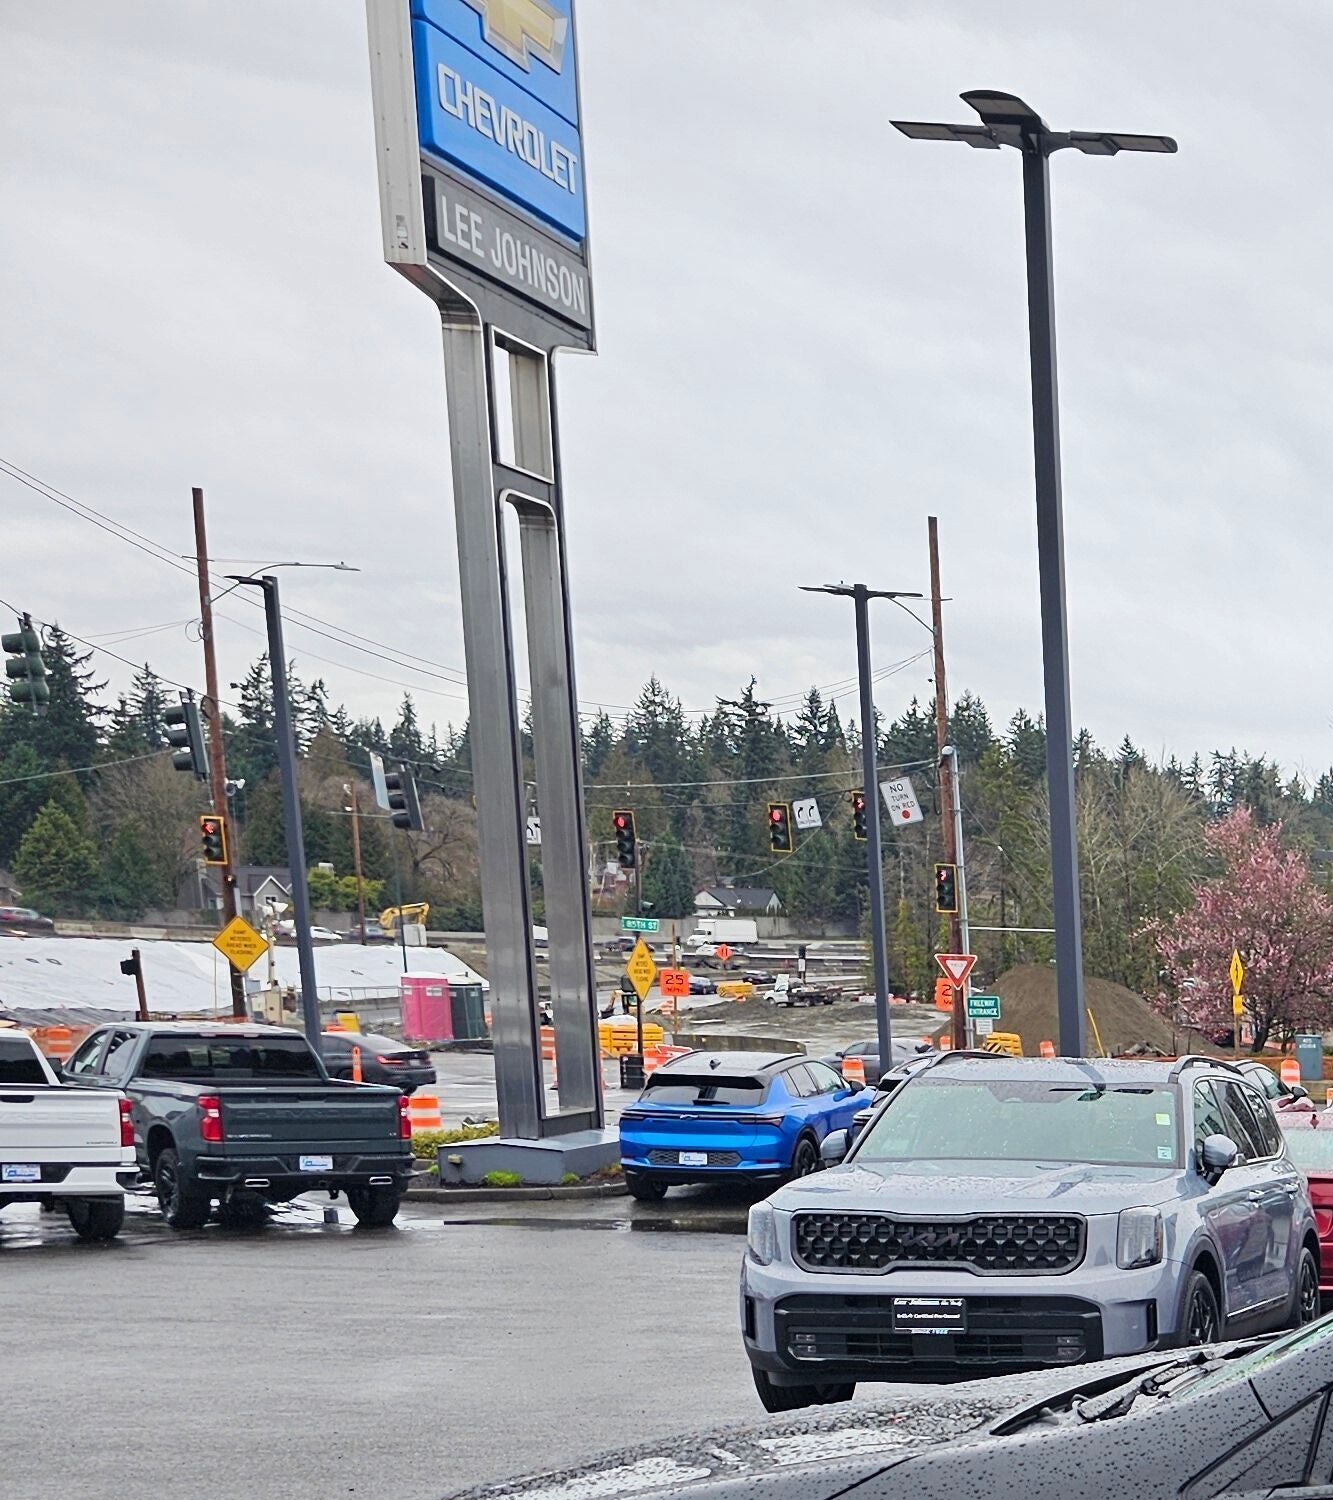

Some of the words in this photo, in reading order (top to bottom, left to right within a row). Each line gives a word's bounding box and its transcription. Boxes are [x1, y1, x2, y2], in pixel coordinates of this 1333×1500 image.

[437, 62, 577, 195] CHEVROLET
[442, 196, 486, 258] LEE
[490, 226, 586, 316] JOHNSON
[889, 783, 904, 793] NO
[891, 793, 909, 802] TURN
[891, 803, 902, 812] ON
[901, 800, 916, 808] RED
[626, 920, 646, 929] 85TH
[648, 921, 657, 930] ST
[665, 974, 684, 985] 25
[969, 999, 995, 1007] FREEWAY
